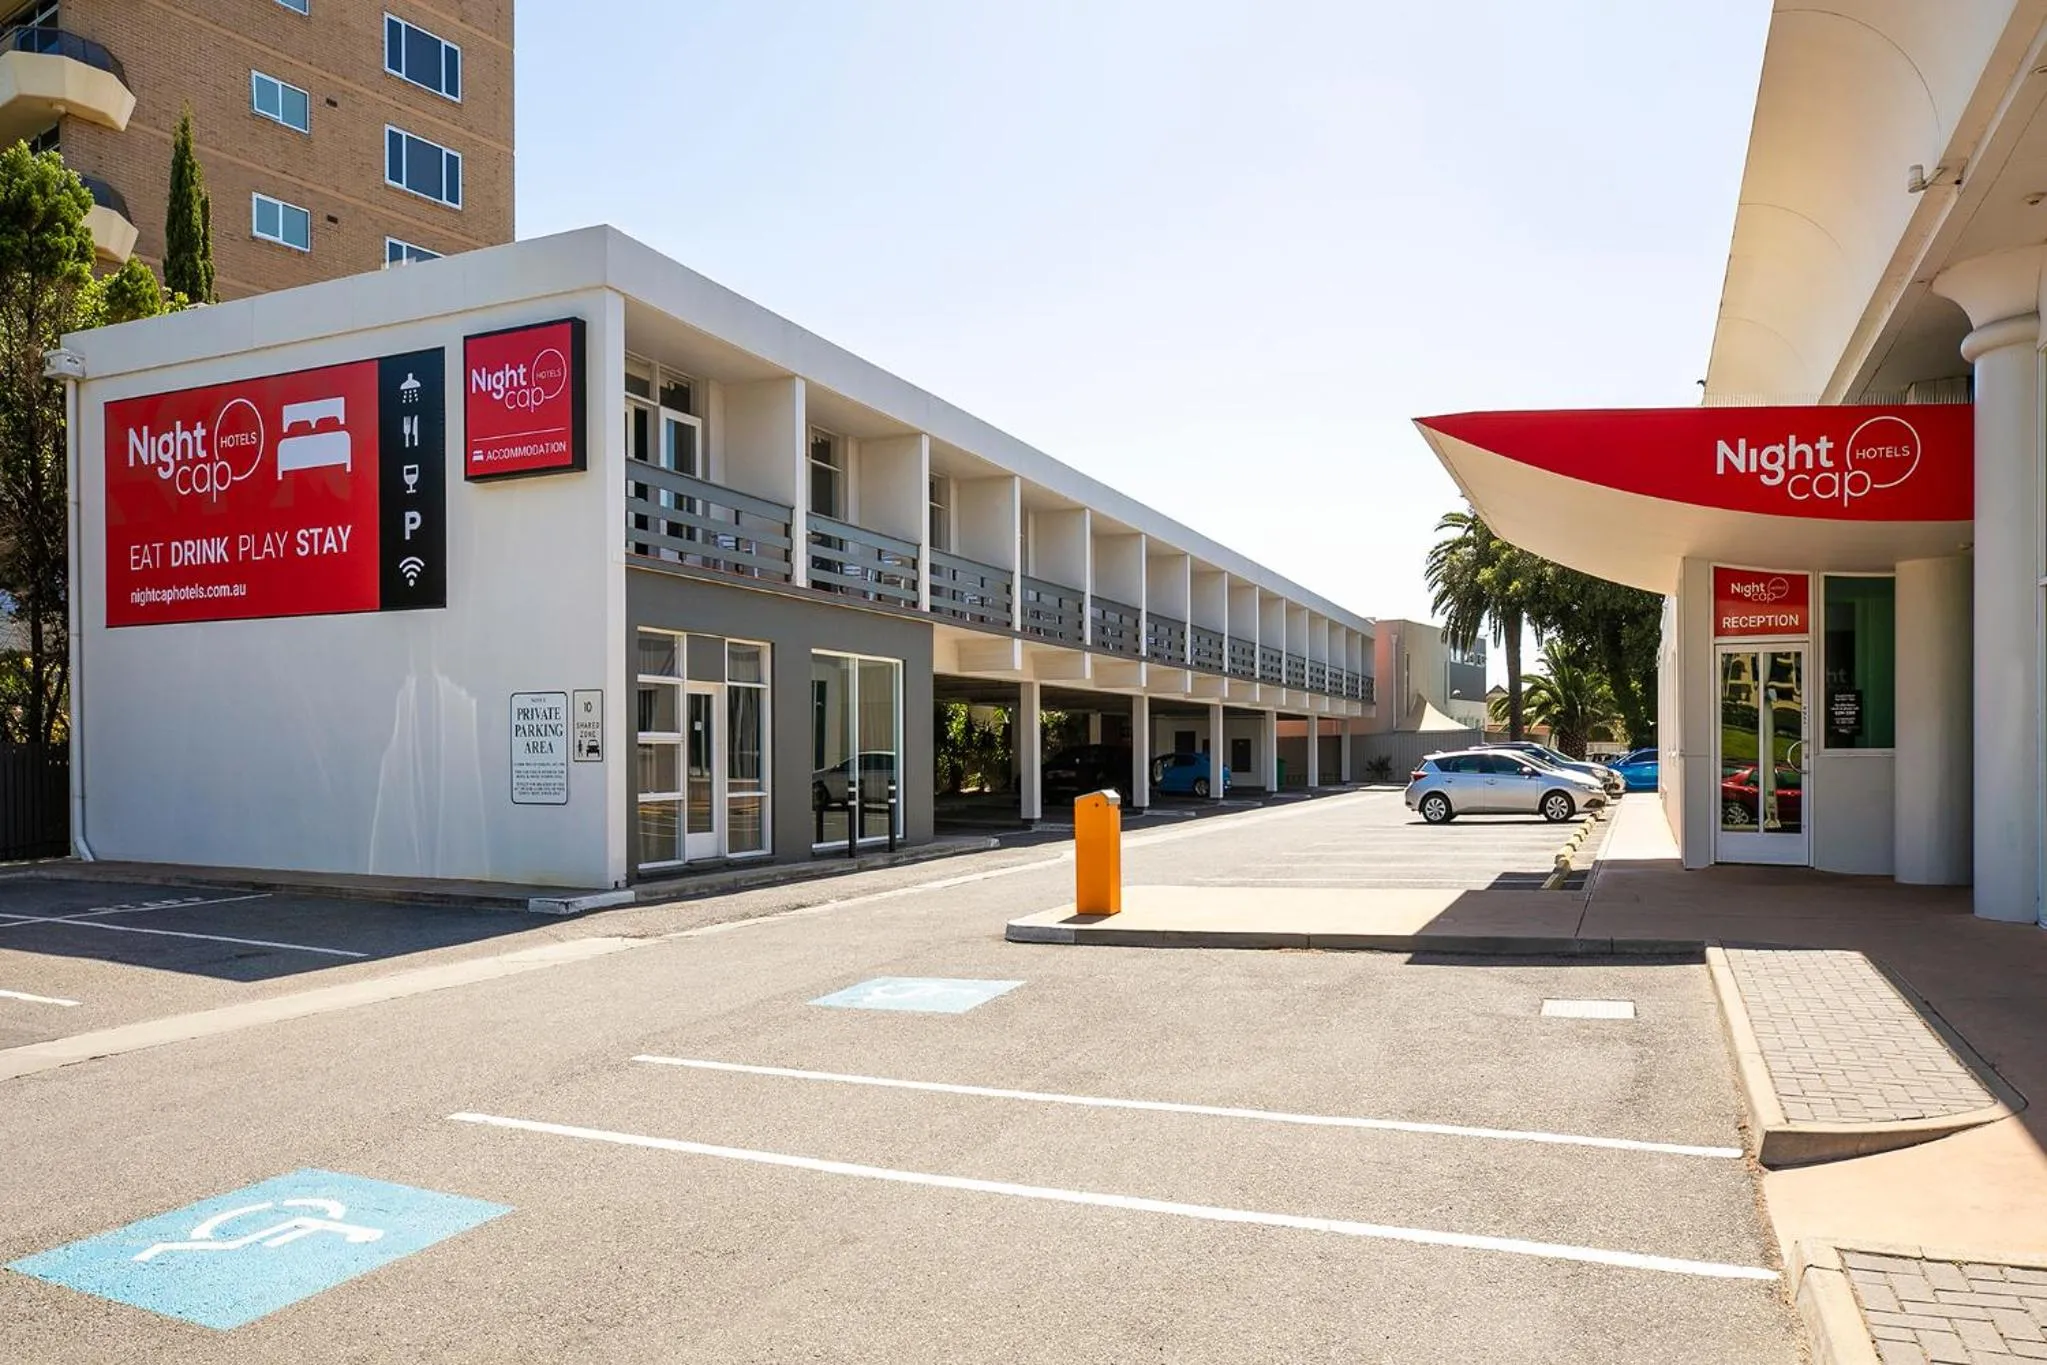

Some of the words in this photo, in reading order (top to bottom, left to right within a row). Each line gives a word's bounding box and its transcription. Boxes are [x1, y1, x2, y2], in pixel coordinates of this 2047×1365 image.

[471, 363, 527, 400] Night
[536, 368, 562, 380] HOTELS
[505, 387, 544, 413] cap
[220, 431, 257, 448] HOTELS
[128, 420, 207, 480] Night
[486, 441, 567, 461] ACCOMMODATION
[1855, 445, 1911, 460] HOTELS
[1716, 434, 1834, 487] Night
[176, 460, 232, 503] cap
[1787, 470, 1872, 508] cap
[404, 511, 421, 541] P
[130, 542, 164, 571] EAT
[170, 536, 229, 567] DRINK
[238, 531, 289, 561] PLAY
[296, 524, 352, 557] STAY
[130, 583, 247, 607] nightcaphotels.com.au
[1731, 582, 1766, 598] Night
[1751, 591, 1776, 604] cap
[1722, 614, 1800, 629] RECEPTION
[516, 707, 562, 721] PRIVATE
[583, 701, 593, 713] 10
[514, 723, 564, 738] PARKING
[576, 721, 600, 730] SHARED
[579, 730, 597, 738] ZONE
[524, 741, 554, 754] AREA
